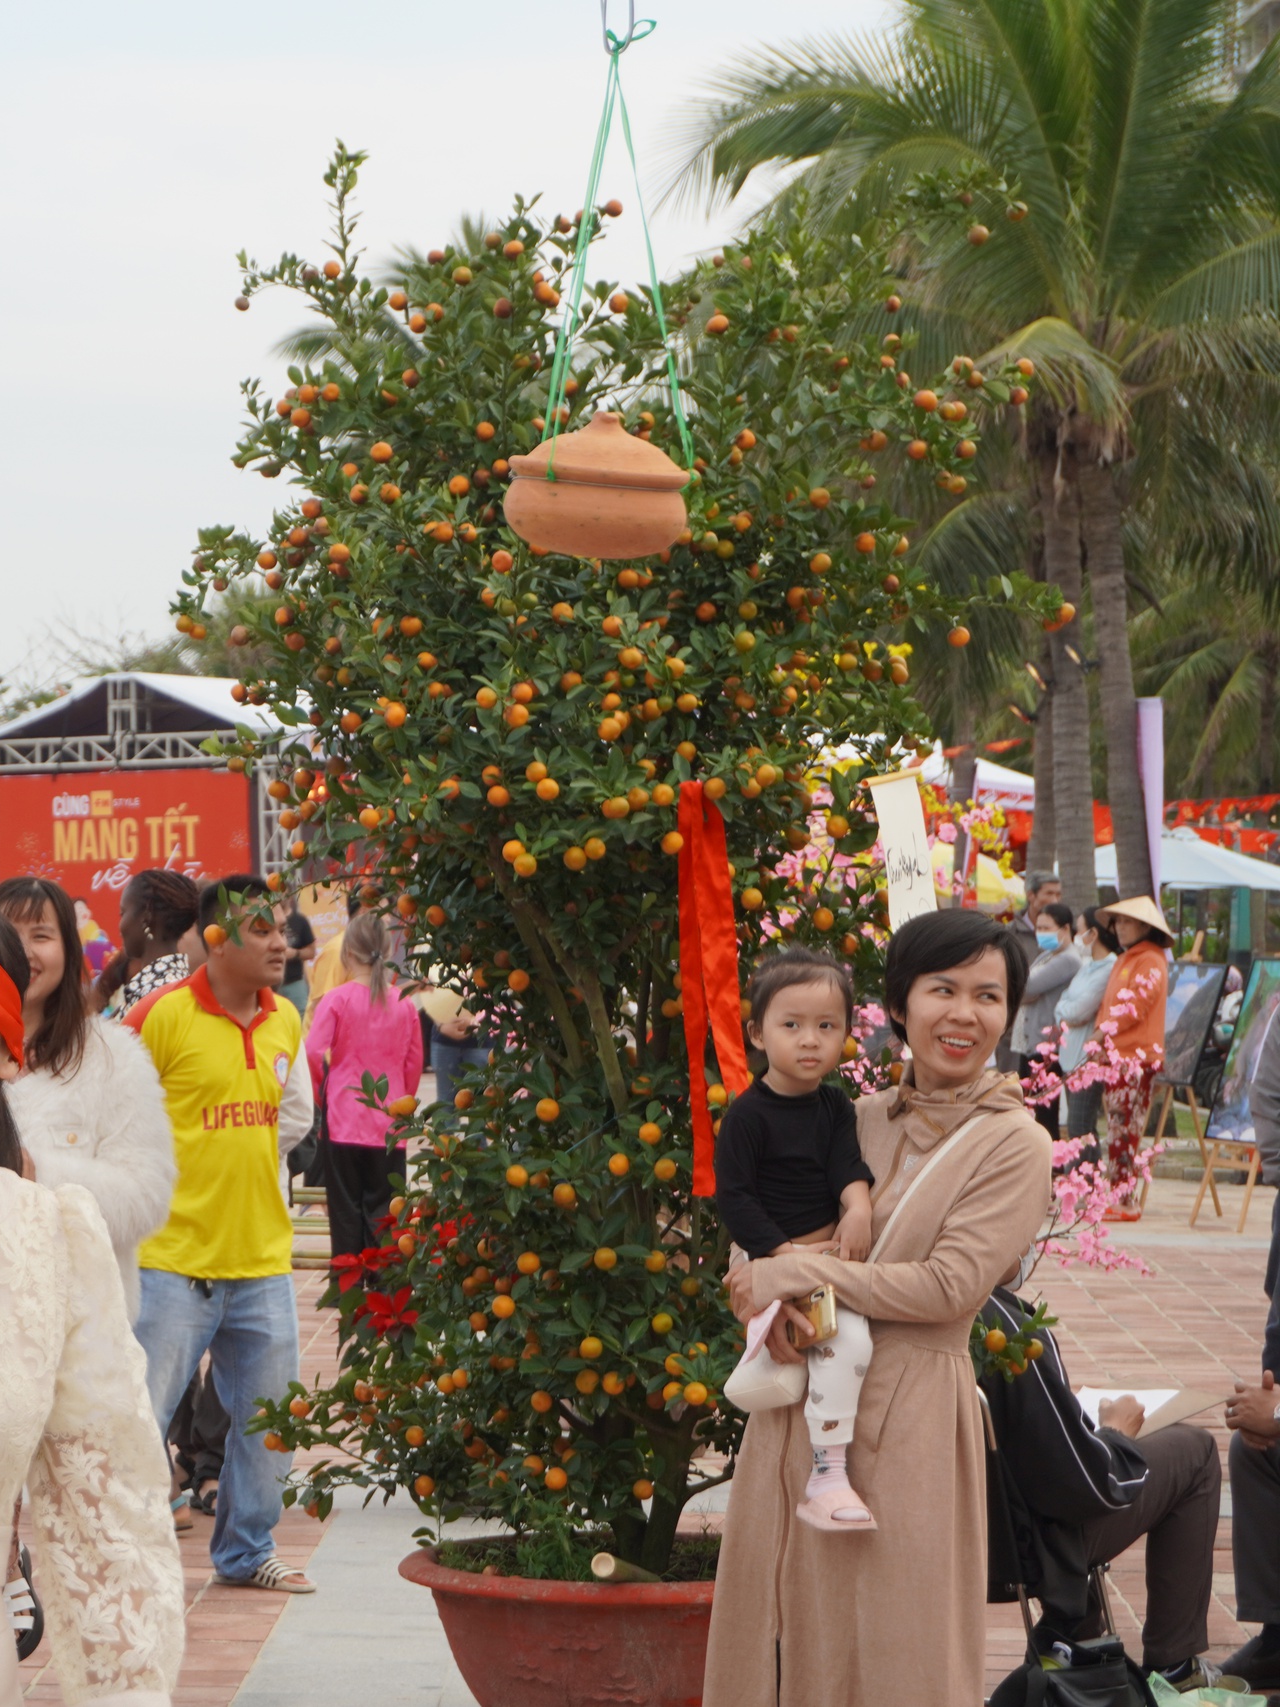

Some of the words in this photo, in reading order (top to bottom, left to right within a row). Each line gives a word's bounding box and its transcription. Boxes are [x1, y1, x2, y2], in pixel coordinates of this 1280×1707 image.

[52, 792, 89, 816] CÙNG
[113, 797, 140, 808] STYLE
[53, 818, 138, 862] MANG
[144, 803, 200, 859] TẾT
[308, 911, 339, 926] HECK
